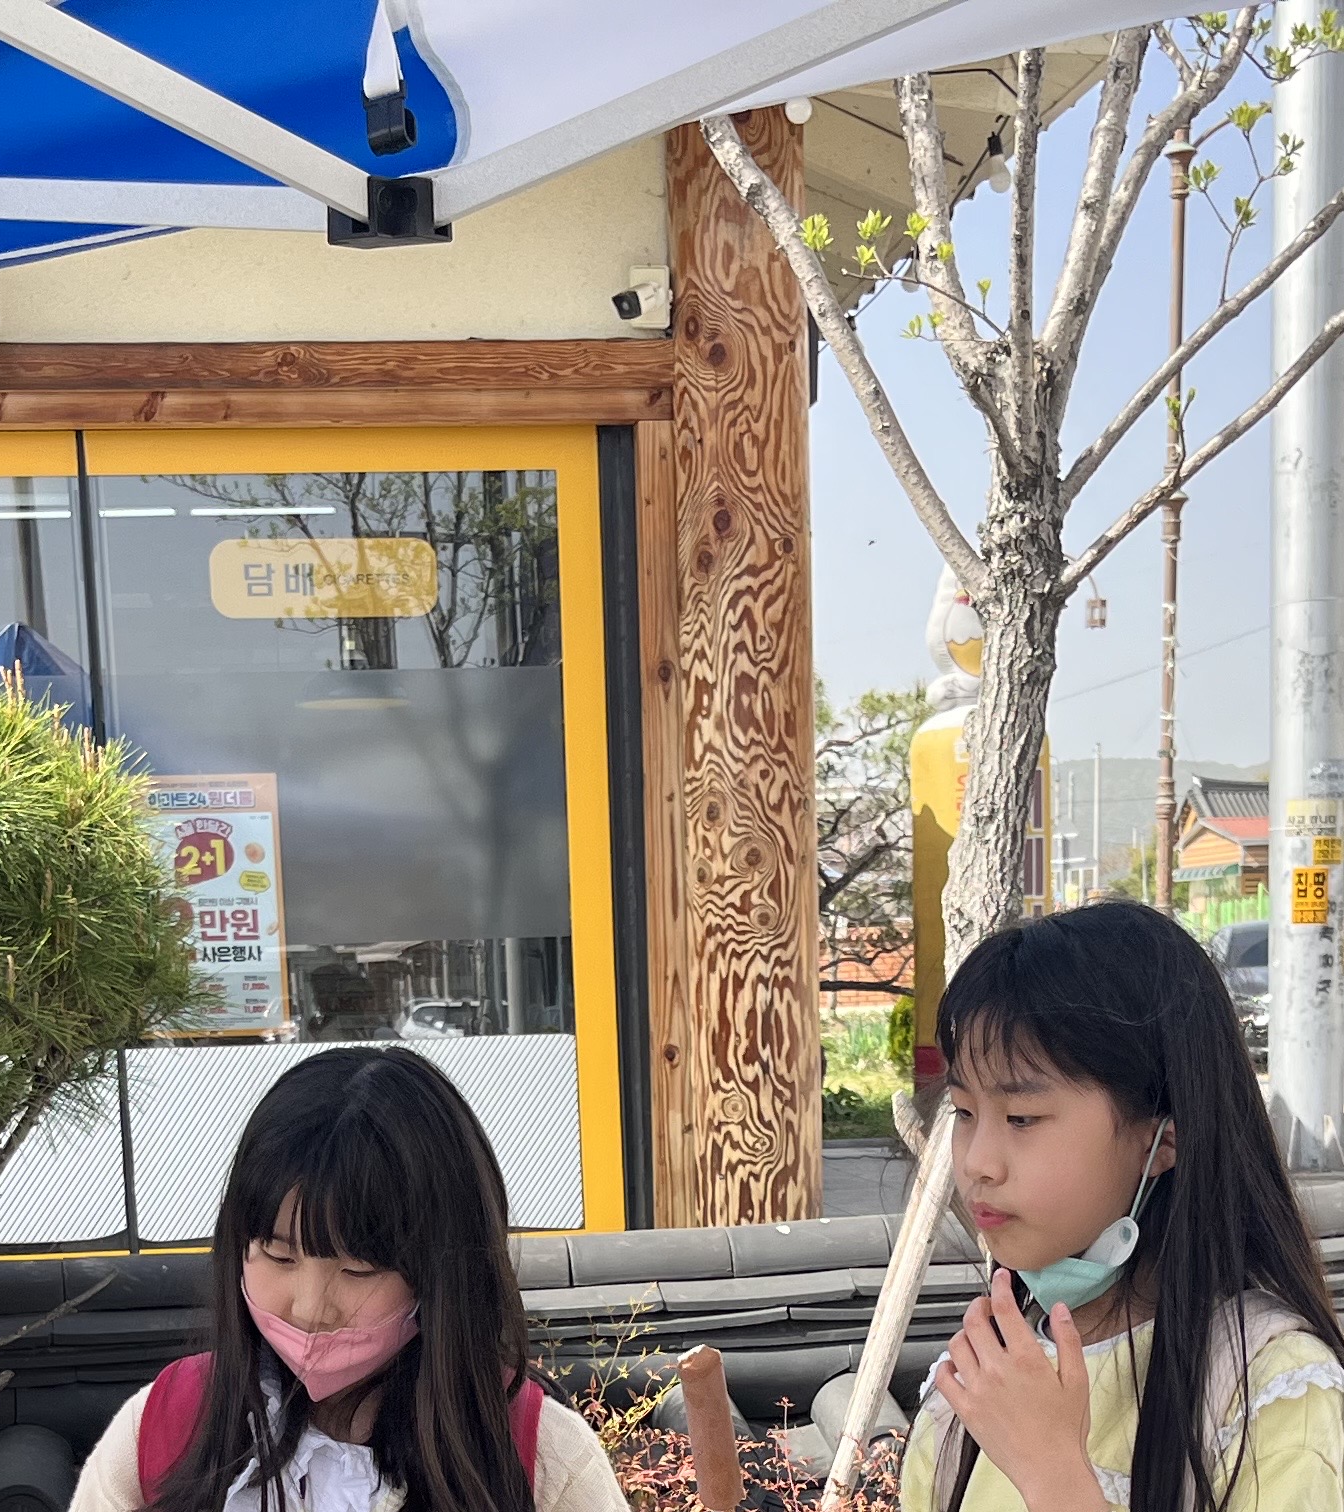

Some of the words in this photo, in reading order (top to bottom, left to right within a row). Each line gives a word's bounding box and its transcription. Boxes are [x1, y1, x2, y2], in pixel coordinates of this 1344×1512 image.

[243, 562, 316, 597] 담배
[179, 839, 227, 877] 2+1
[201, 945, 263, 963] 사은행사
